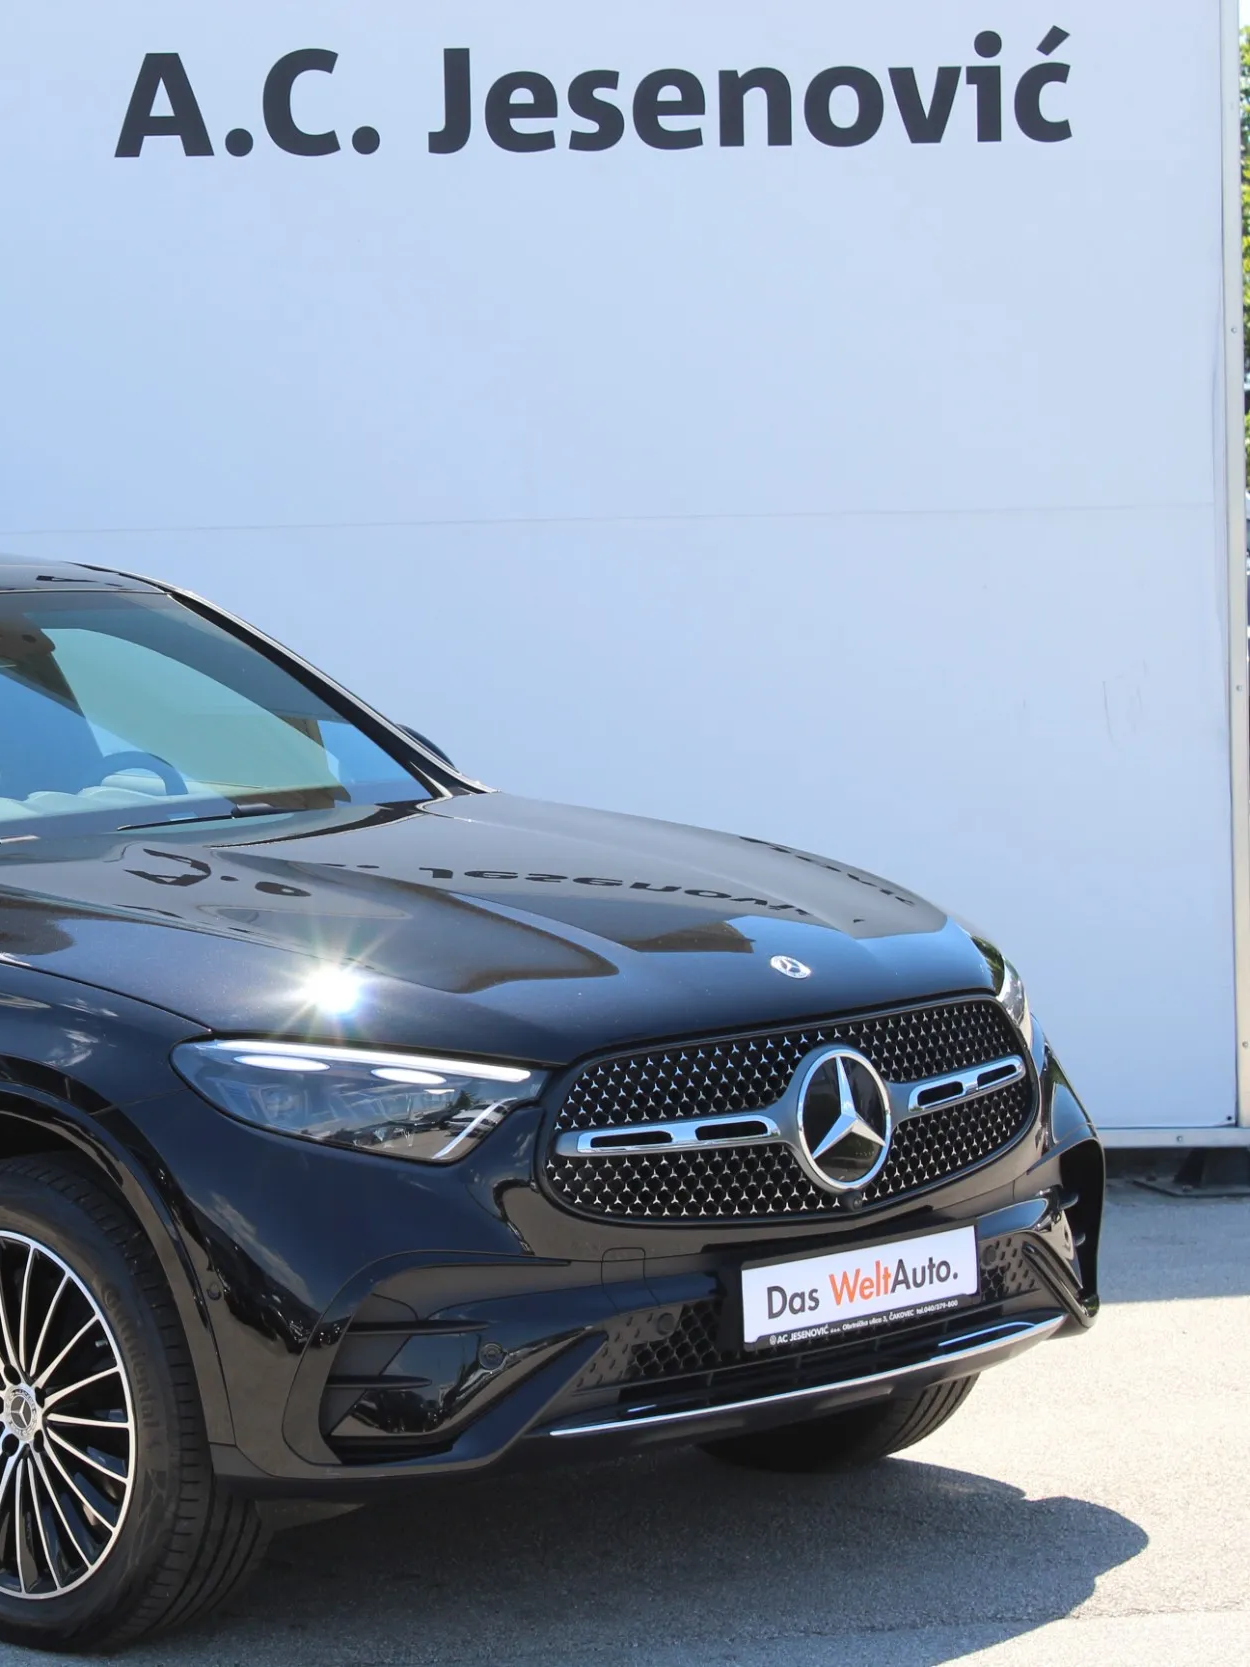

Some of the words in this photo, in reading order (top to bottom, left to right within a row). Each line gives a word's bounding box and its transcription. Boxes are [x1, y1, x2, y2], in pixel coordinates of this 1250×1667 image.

[114, 48, 380, 158] A.C.
[428, 25, 1072, 154] Jesenović
[766, 1285, 820, 1320] Das
[828, 1257, 959, 1306] WeltAuto.
[789, 1324, 829, 1342] JESENOVIĆ
